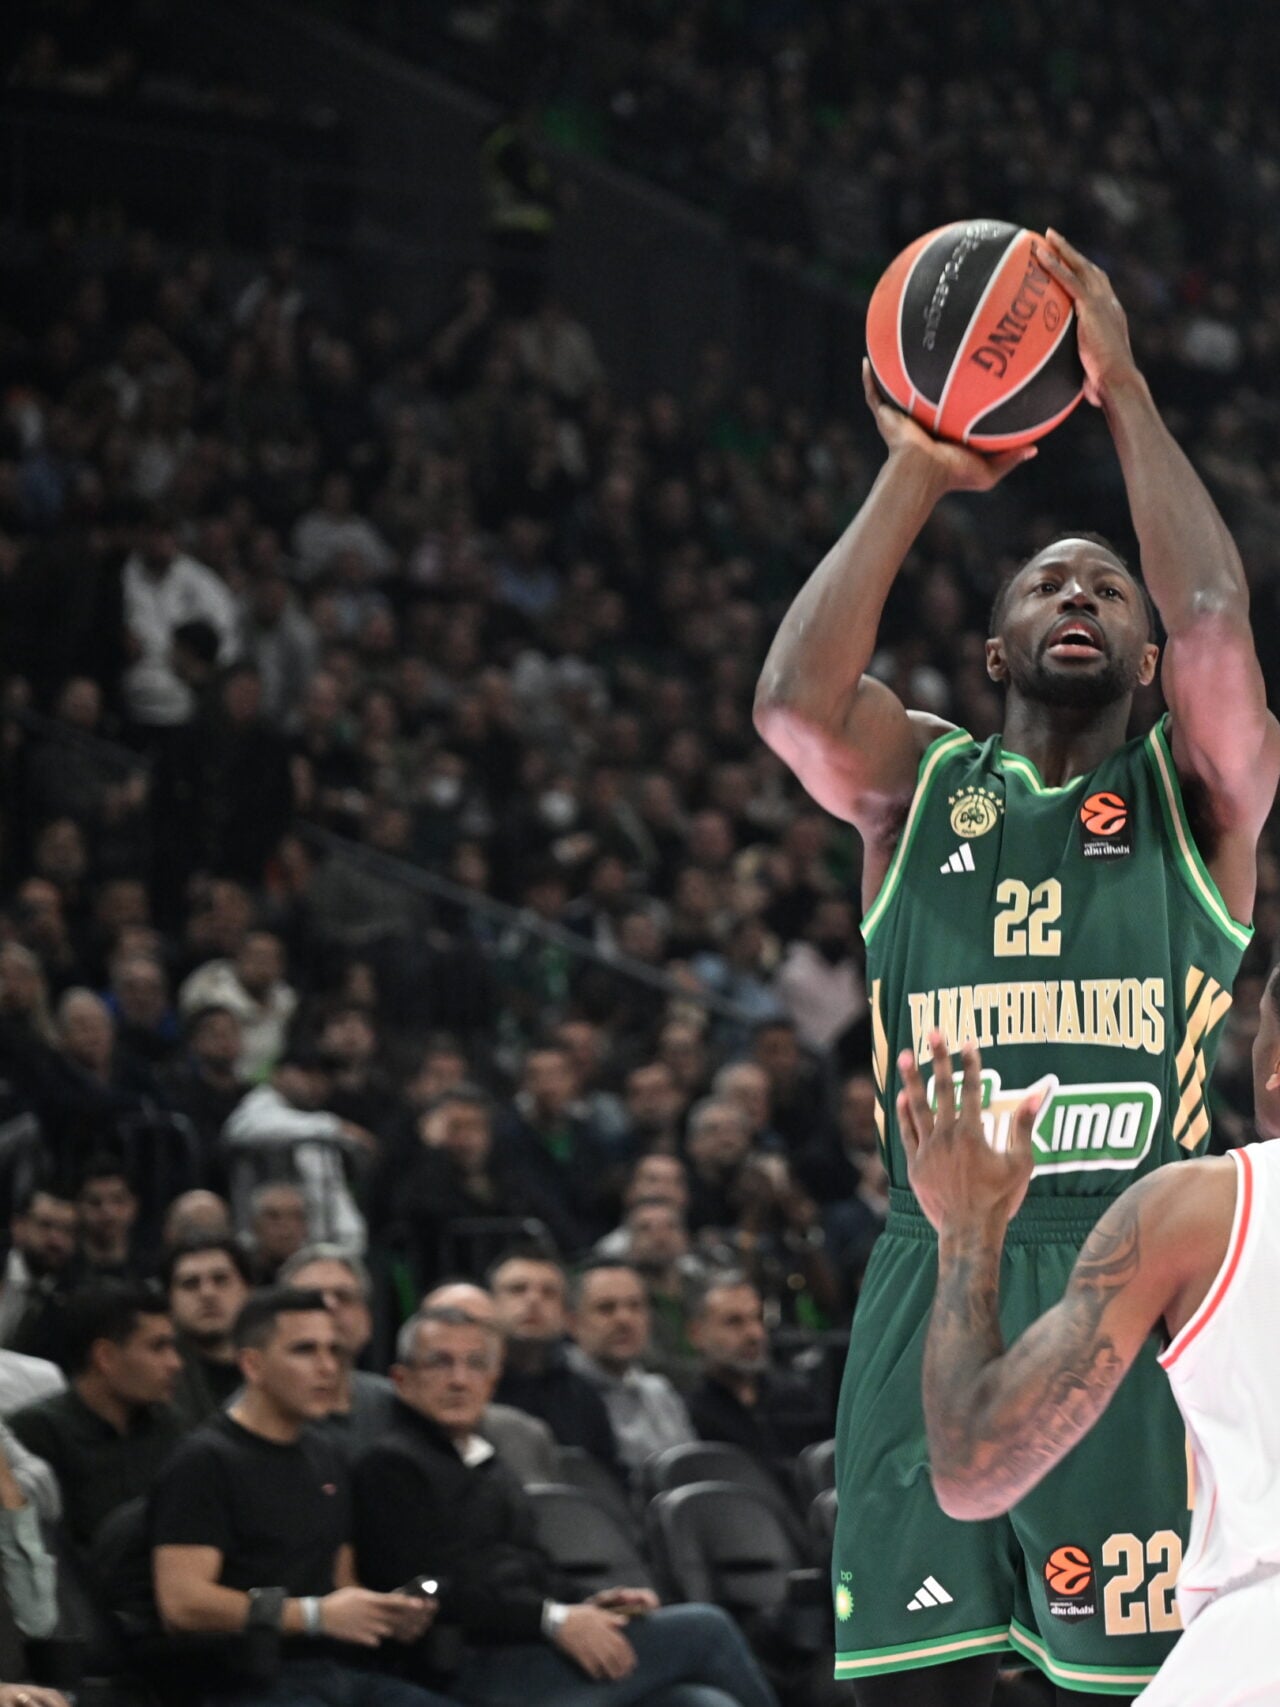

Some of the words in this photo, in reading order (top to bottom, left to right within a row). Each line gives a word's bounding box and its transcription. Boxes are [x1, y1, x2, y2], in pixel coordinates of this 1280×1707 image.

[994, 878, 1062, 957] 22
[840, 1569, 853, 1583] bp
[1102, 1530, 1187, 1636] 22
